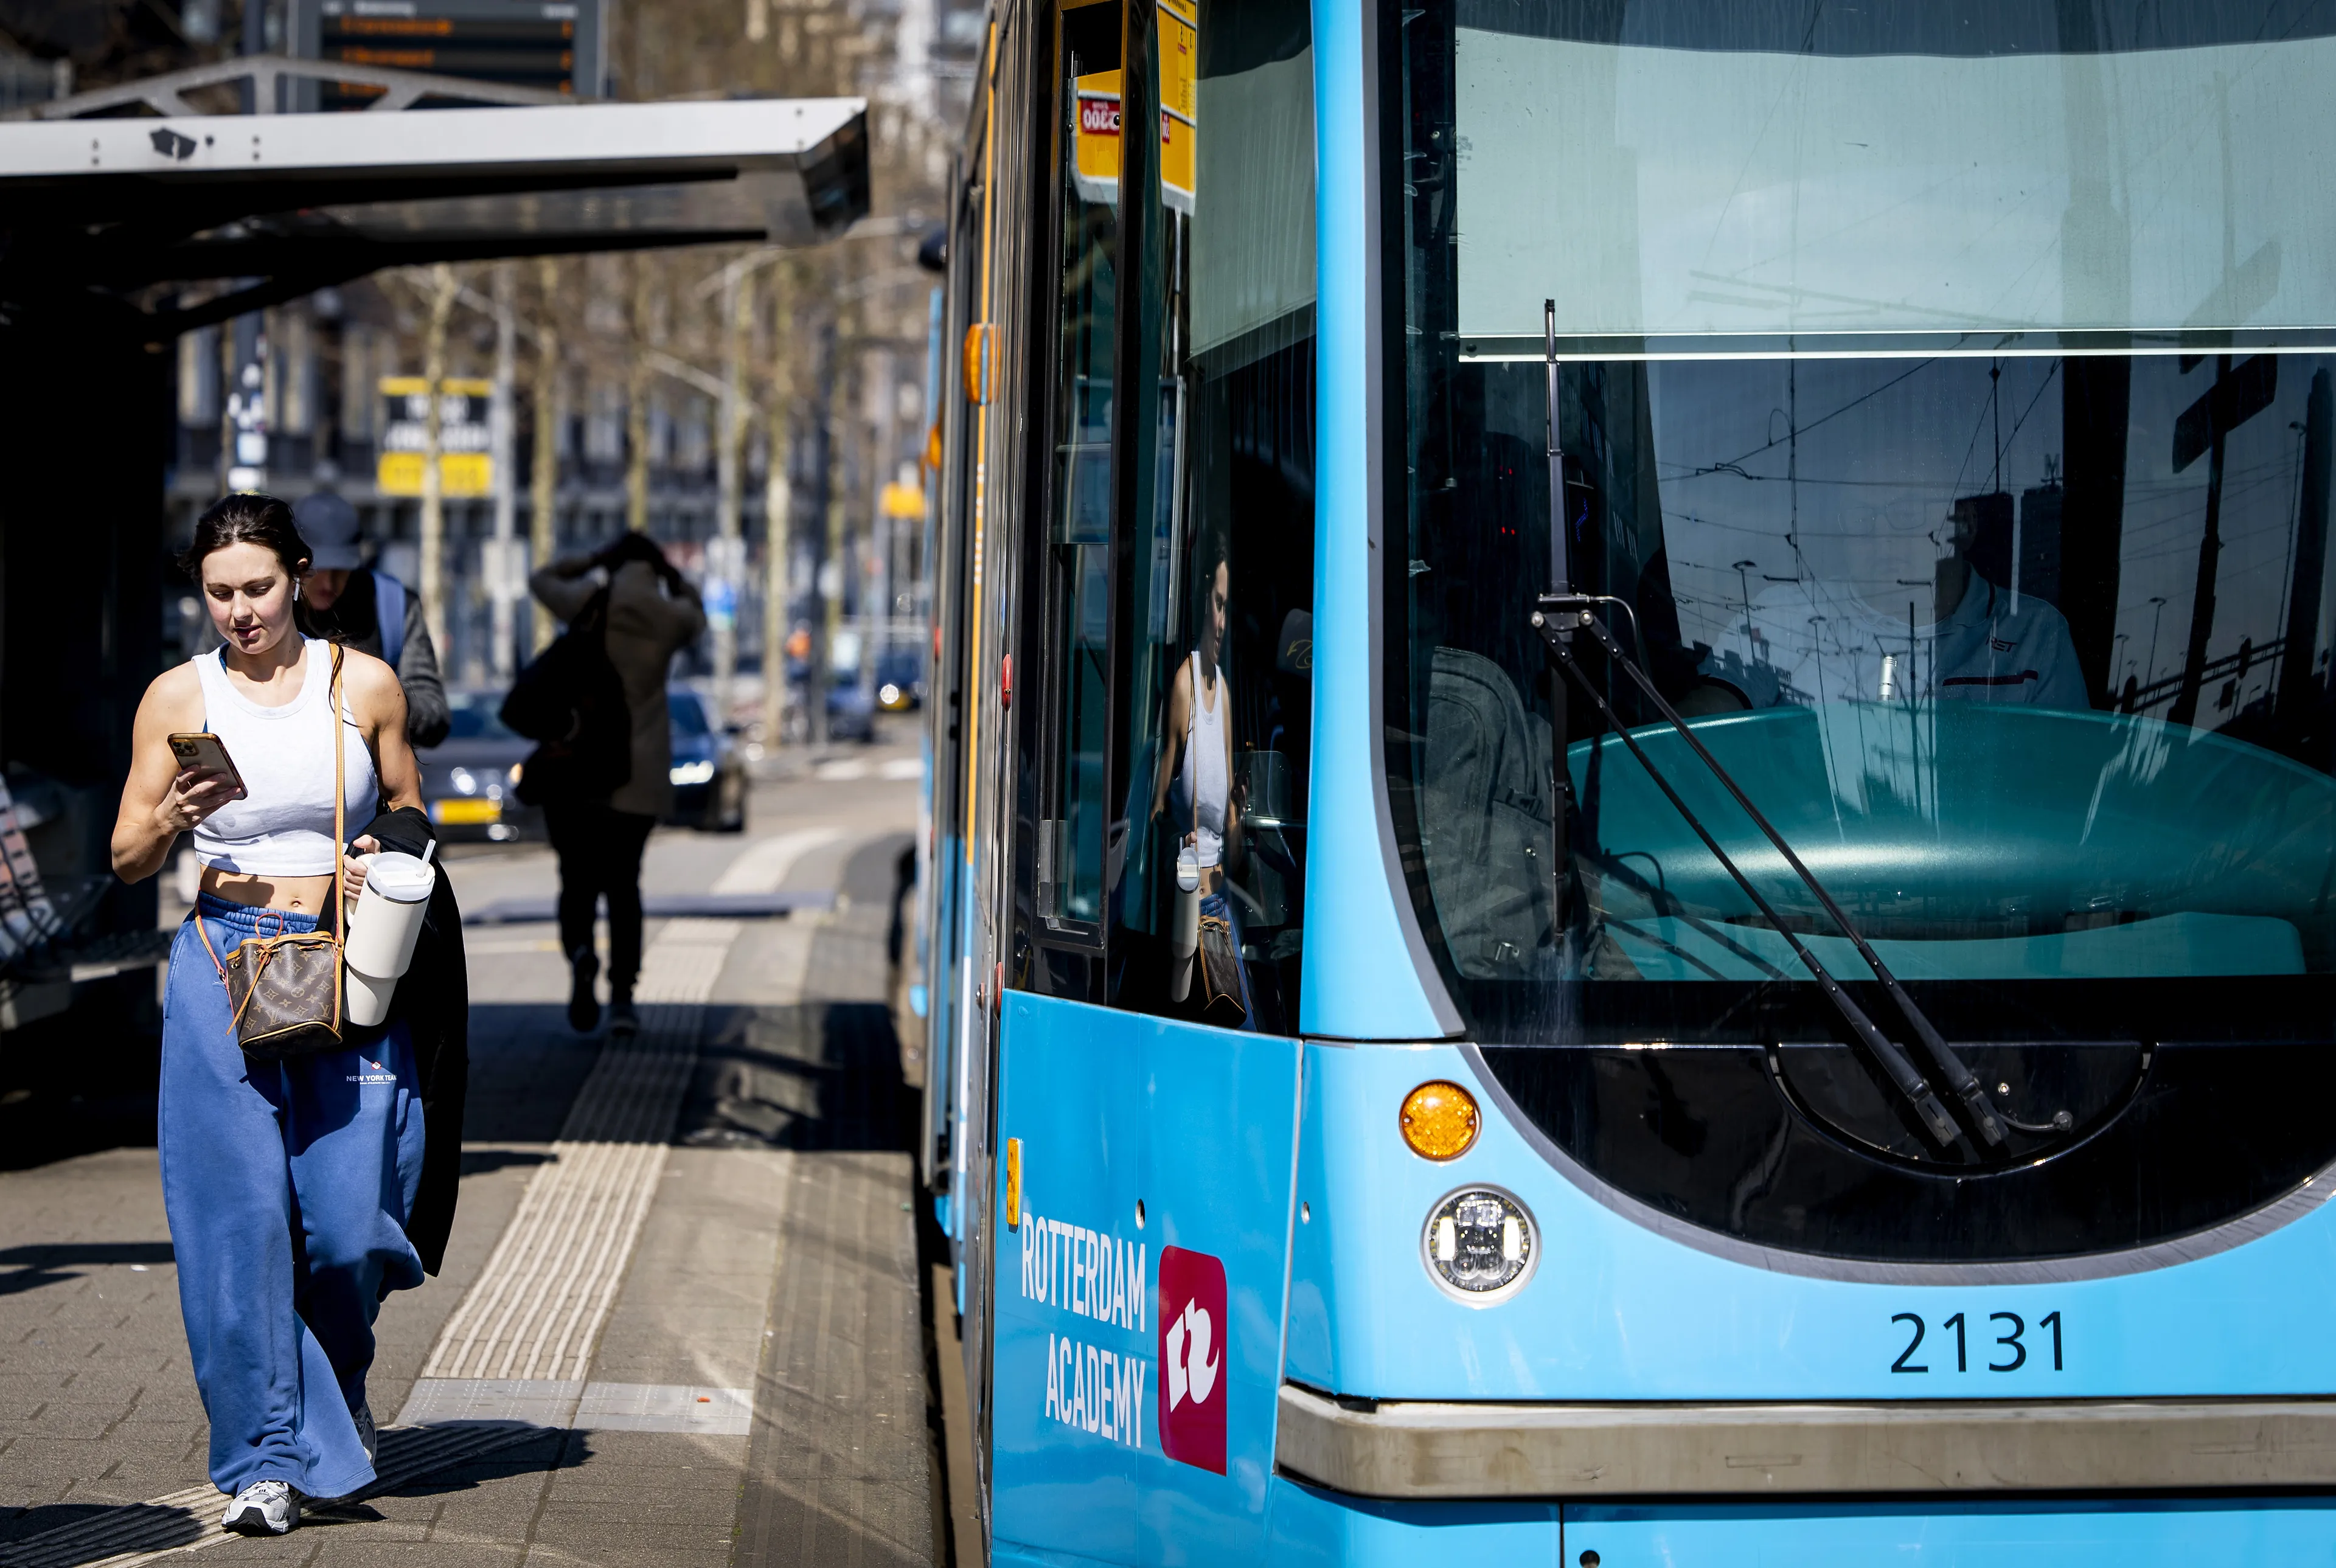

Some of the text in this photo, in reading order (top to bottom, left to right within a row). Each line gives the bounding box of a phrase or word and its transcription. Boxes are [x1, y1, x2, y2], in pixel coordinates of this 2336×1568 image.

[1021, 1212, 1145, 1333] ROTTERDAM
[1046, 1333, 1145, 1449] ACADEMY
[1891, 1311, 2063, 1373] 2131
